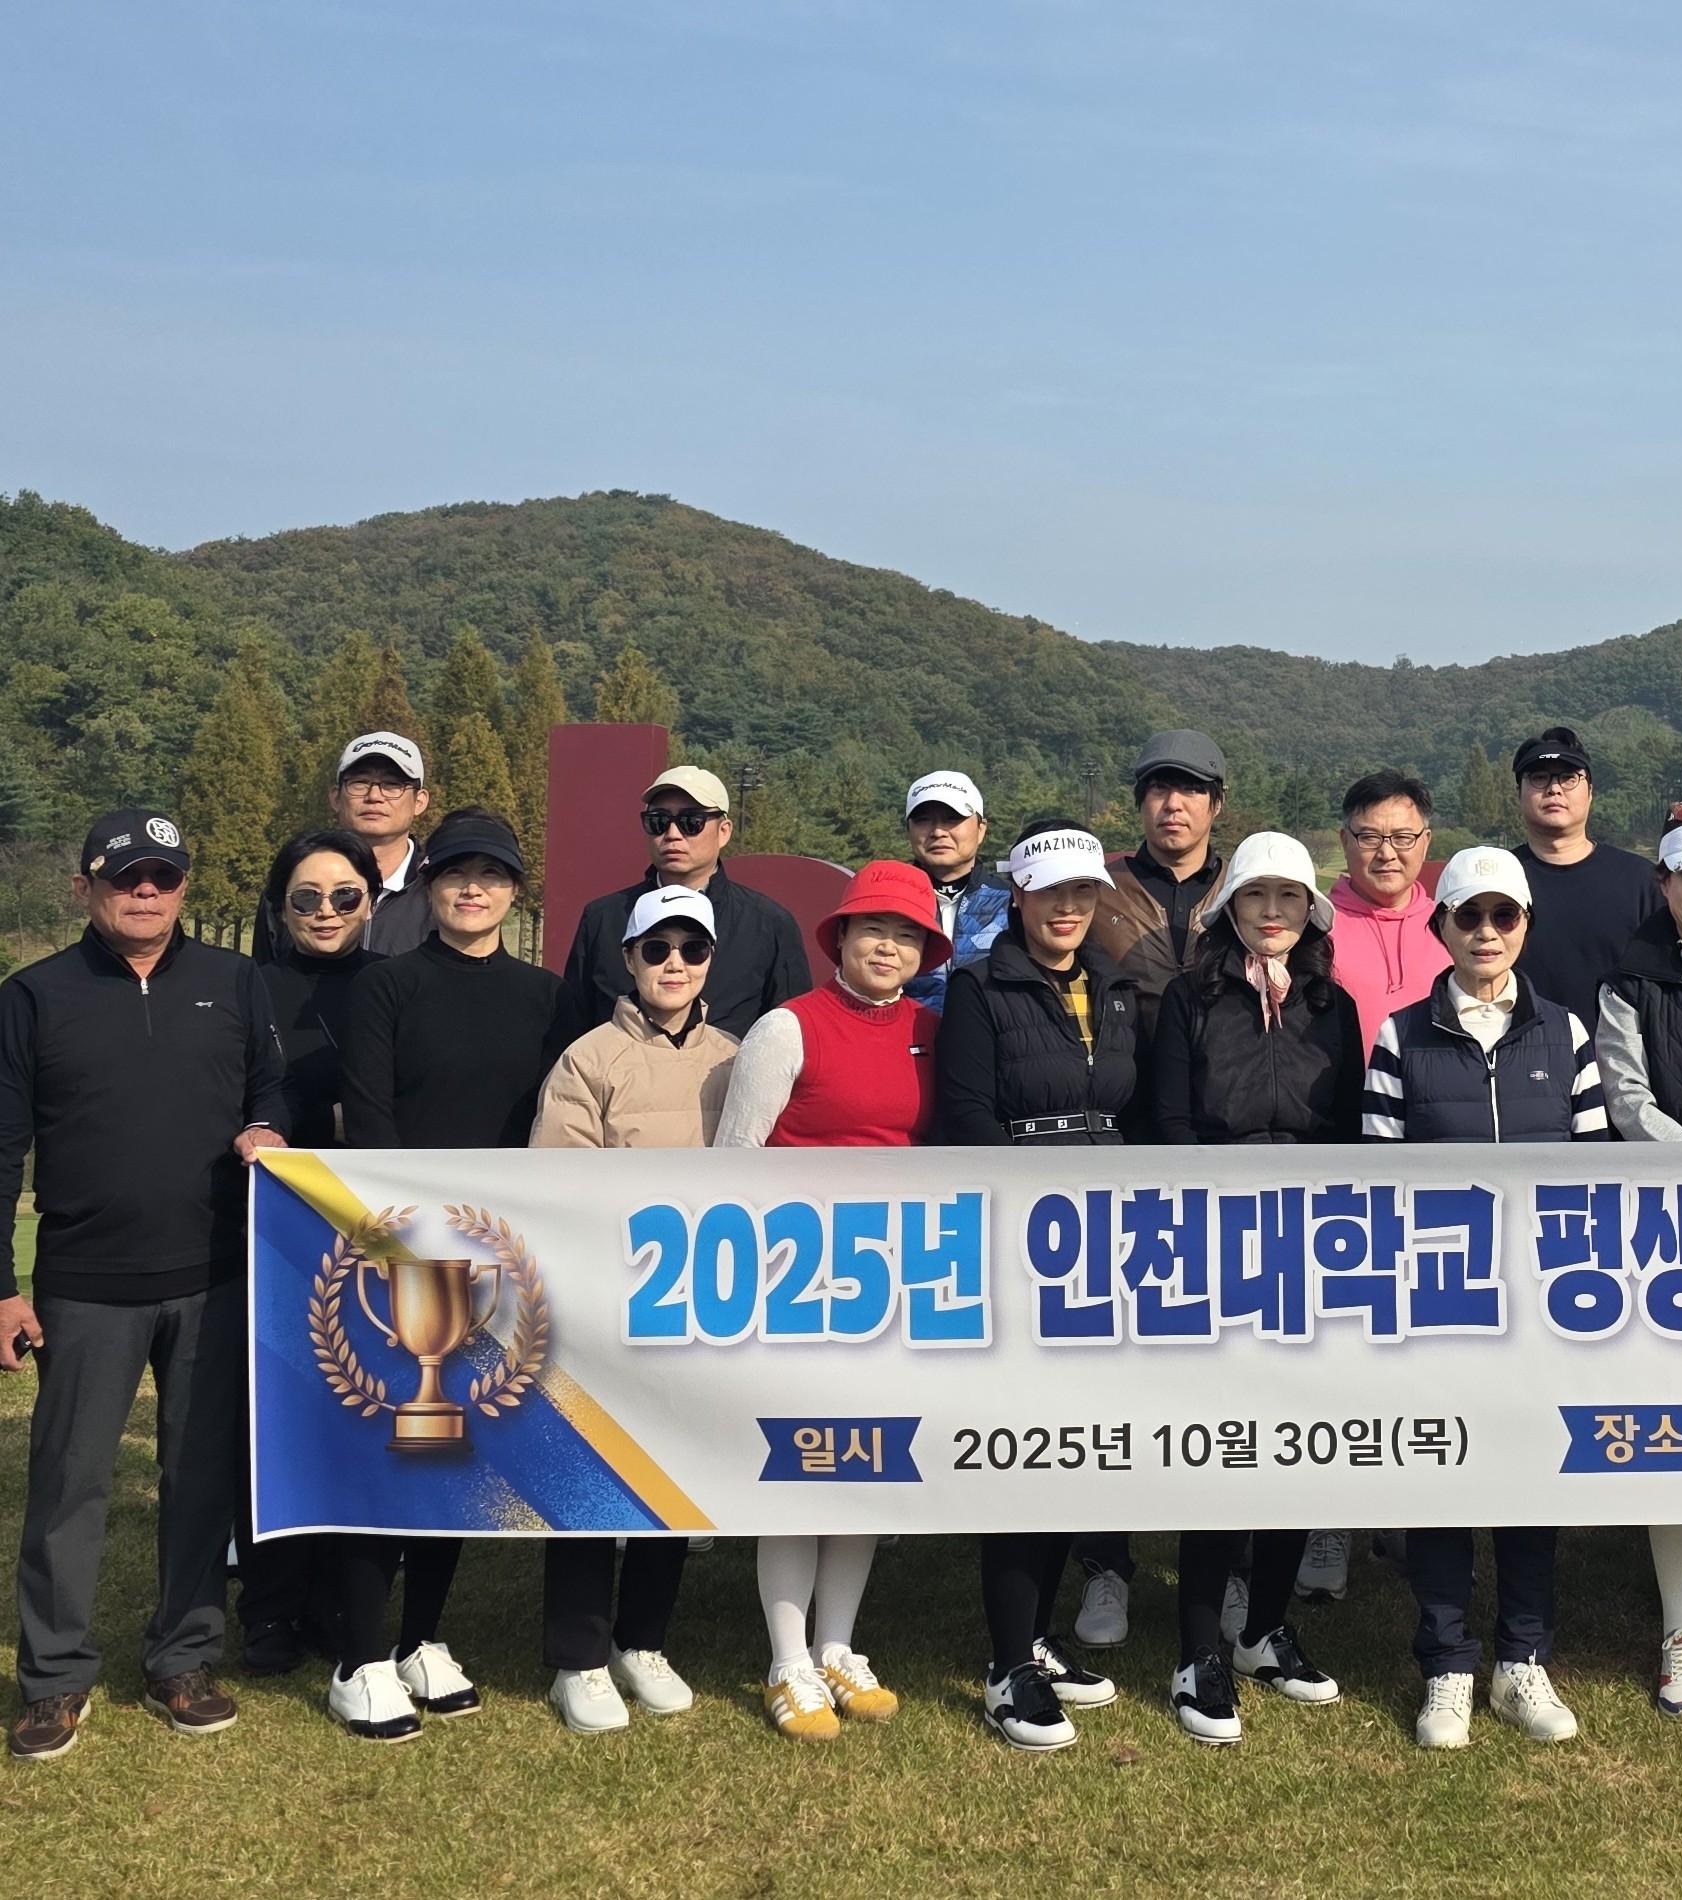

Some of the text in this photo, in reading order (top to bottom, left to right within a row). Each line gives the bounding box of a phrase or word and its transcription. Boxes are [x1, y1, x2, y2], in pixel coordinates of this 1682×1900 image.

[628, 1190, 986, 1341] 2025년
[1027, 1184, 1506, 1338] 인천대학교
[793, 1428, 884, 1473] 일시
[952, 1415, 1469, 1471] 2025년 10월 30일(목)
